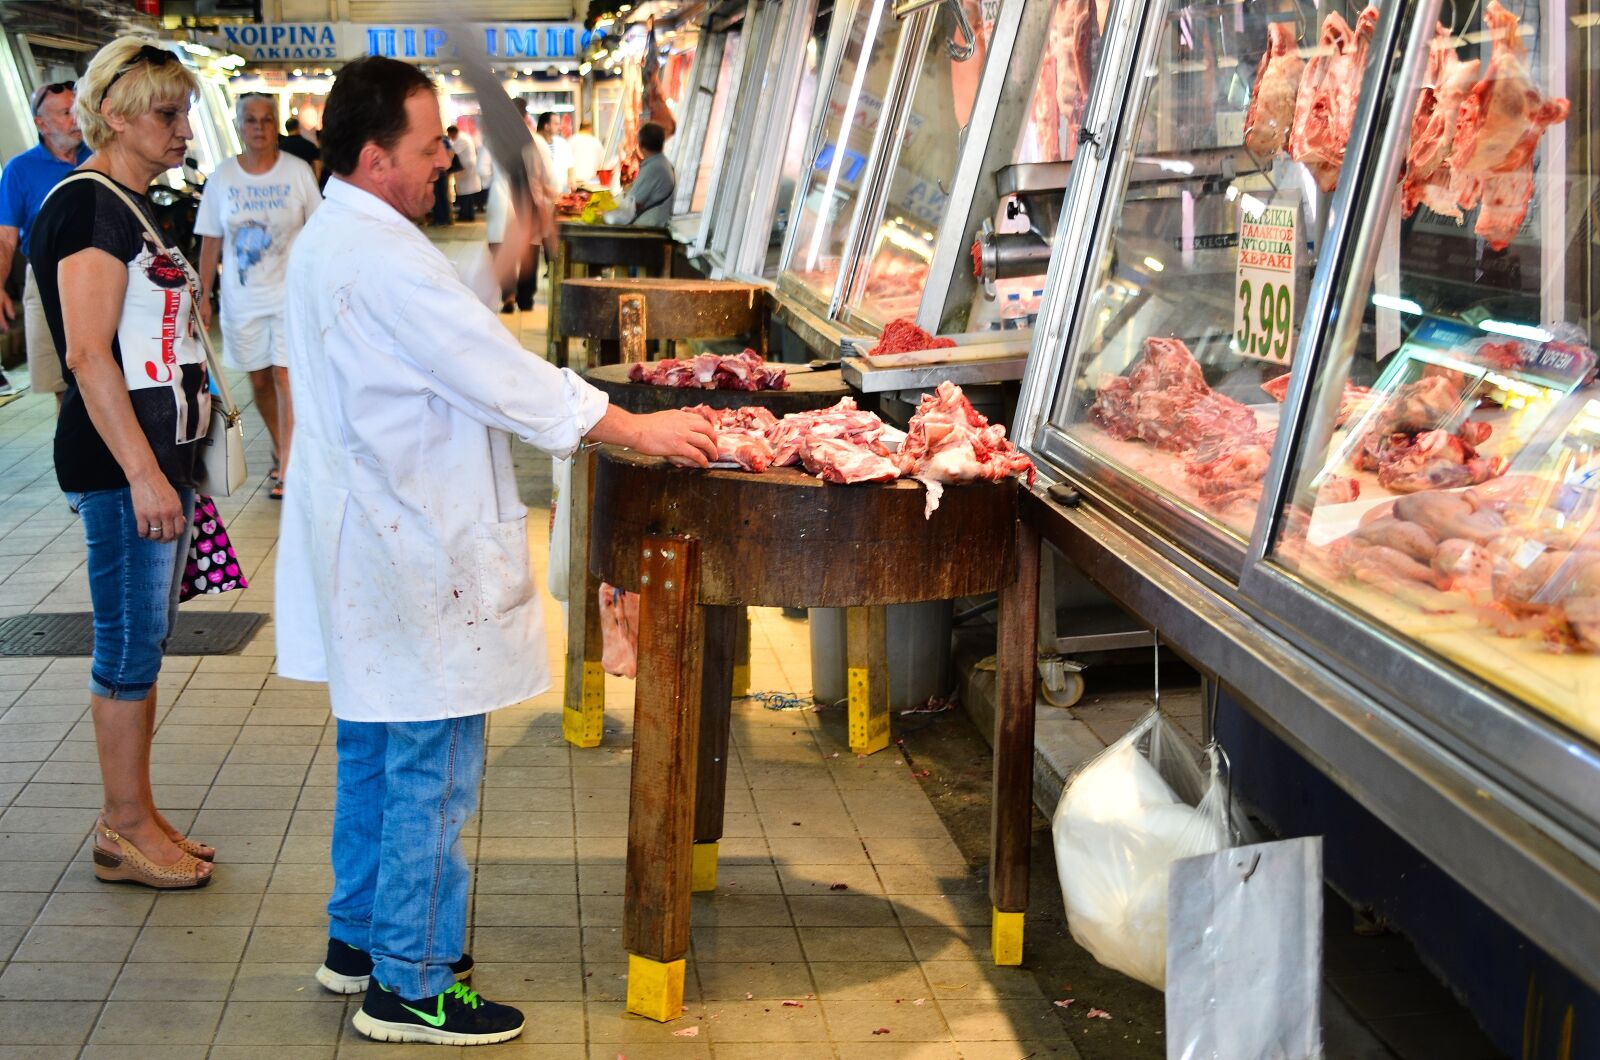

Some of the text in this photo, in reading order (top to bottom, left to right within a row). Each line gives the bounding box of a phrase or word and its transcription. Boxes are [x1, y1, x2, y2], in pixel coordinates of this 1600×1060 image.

[223, 25, 336, 46] ΧΟΙΡΙΝΑ
[1241, 223, 1293, 242] ΓΑΛΑΚΤΟΣ
[1240, 237, 1292, 255] ΝΤΟΠΙΑ
[1240, 250, 1292, 270] ΧΕΡΑΚΙ
[1237, 279, 1291, 360] 3.99
